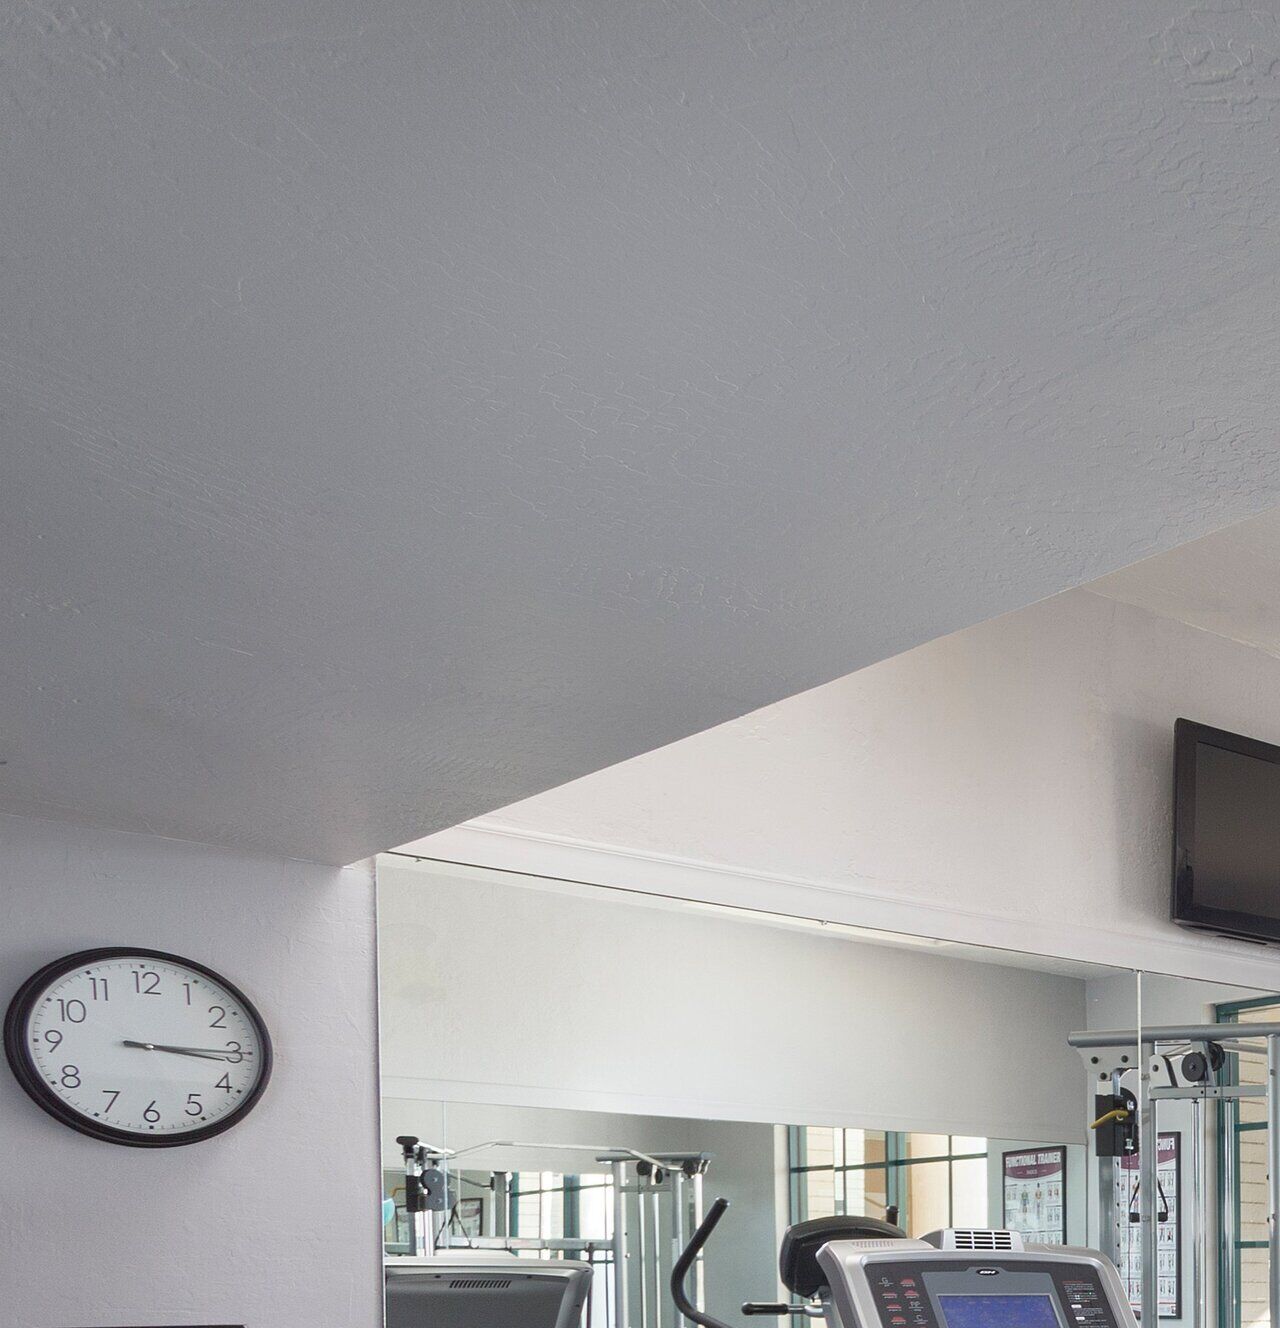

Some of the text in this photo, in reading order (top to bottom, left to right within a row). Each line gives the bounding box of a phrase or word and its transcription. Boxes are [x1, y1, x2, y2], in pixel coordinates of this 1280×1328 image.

[89, 977, 109, 1001] 11
[132, 970, 162, 995] 12
[183, 983, 191, 1005] 1
[57, 998, 87, 1023] 10
[208, 1006, 227, 1028] 2
[44, 1029, 63, 1053] 9
[225, 1041, 243, 1064] 3
[61, 1065, 81, 1089] 8
[214, 1072, 233, 1094] 4
[102, 1090, 120, 1113] 7
[143, 1100, 161, 1123] 6
[184, 1093, 203, 1116] 5
